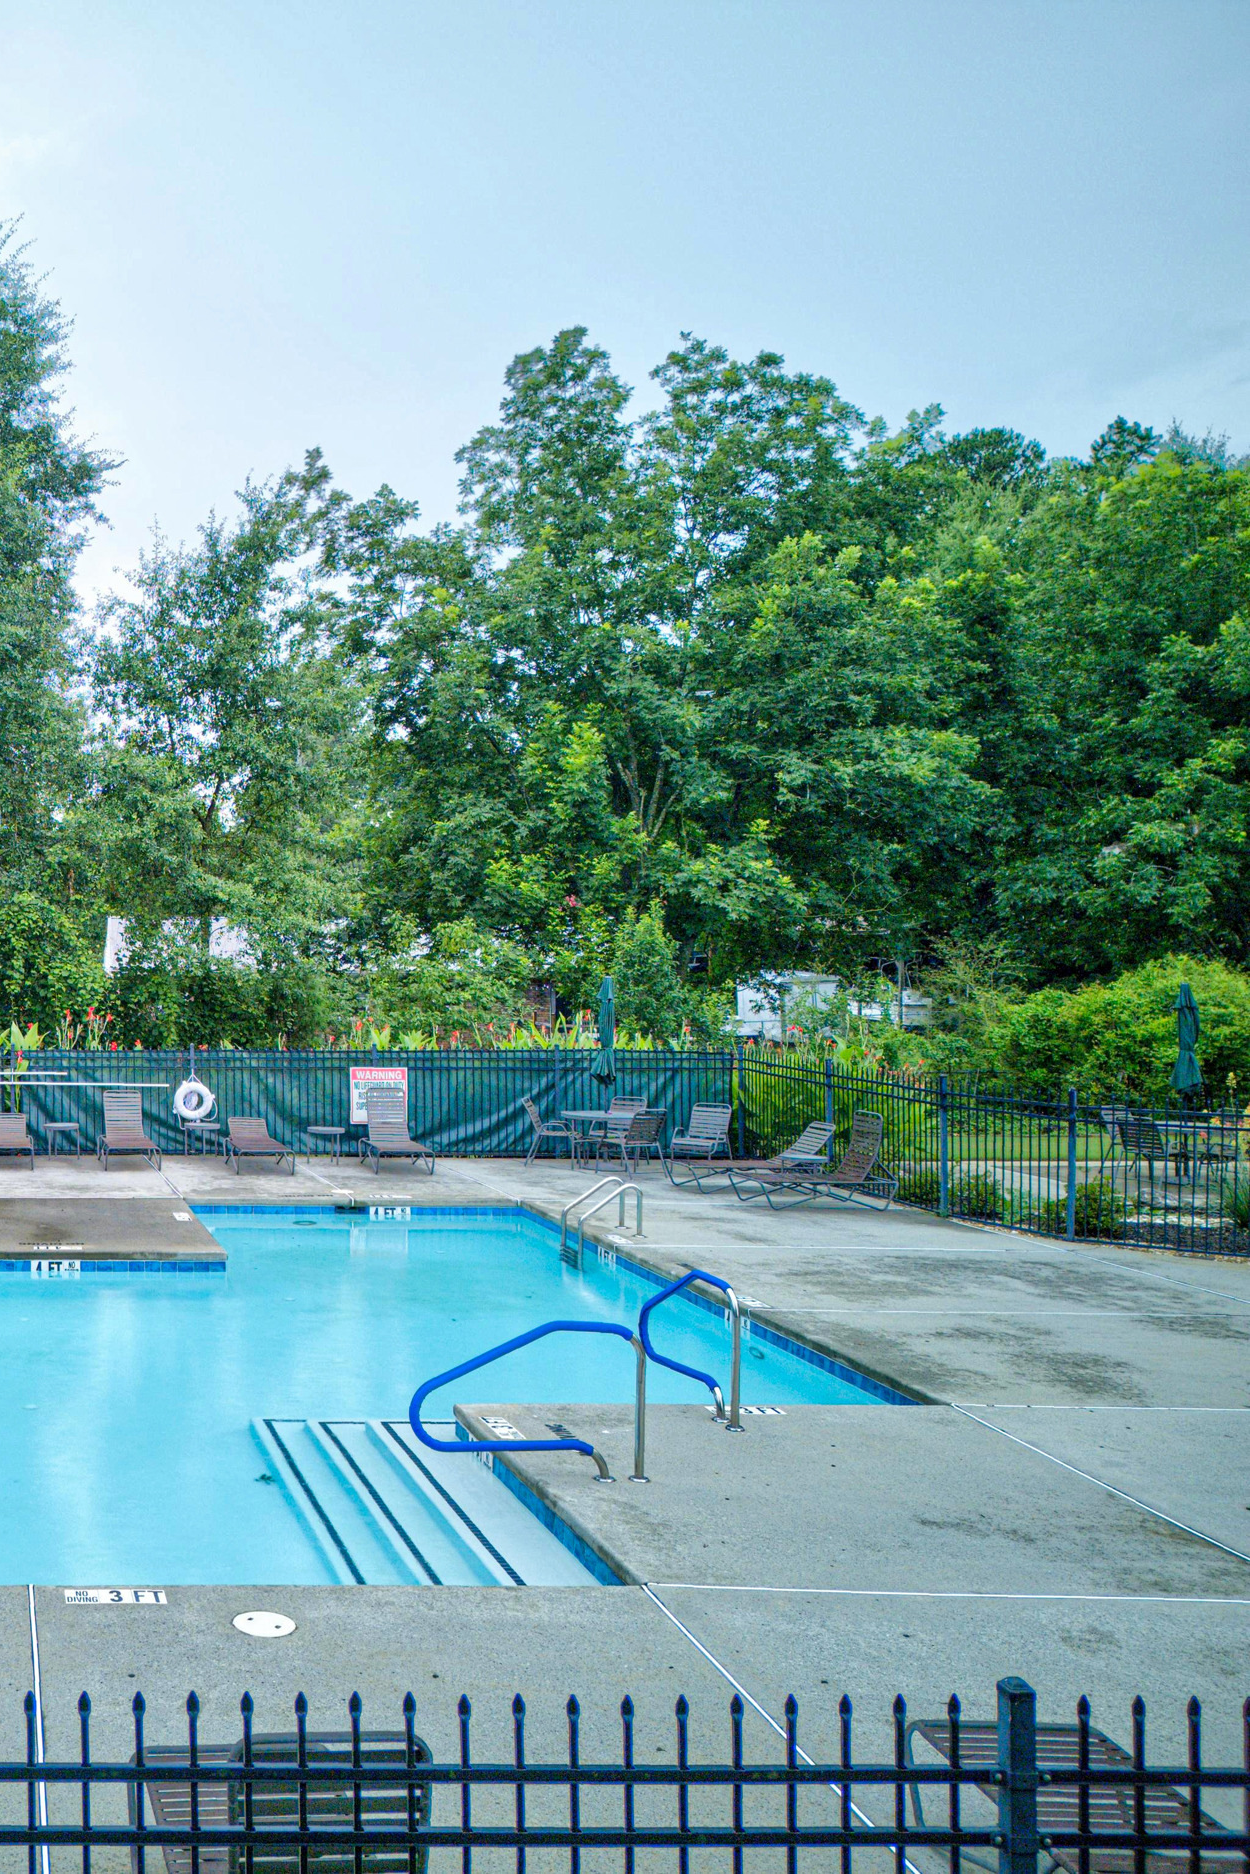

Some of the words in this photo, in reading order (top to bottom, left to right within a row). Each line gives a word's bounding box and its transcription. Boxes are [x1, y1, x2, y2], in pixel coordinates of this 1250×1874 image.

[355, 1070, 403, 1080] WARNING
[384, 1207, 397, 1217] FT
[36, 1261, 42, 1272] 4
[48, 1261, 63, 1272] FT
[755, 1406, 782, 1415] FT
[109, 1590, 123, 1603] 3
[133, 1590, 164, 1603] FT
